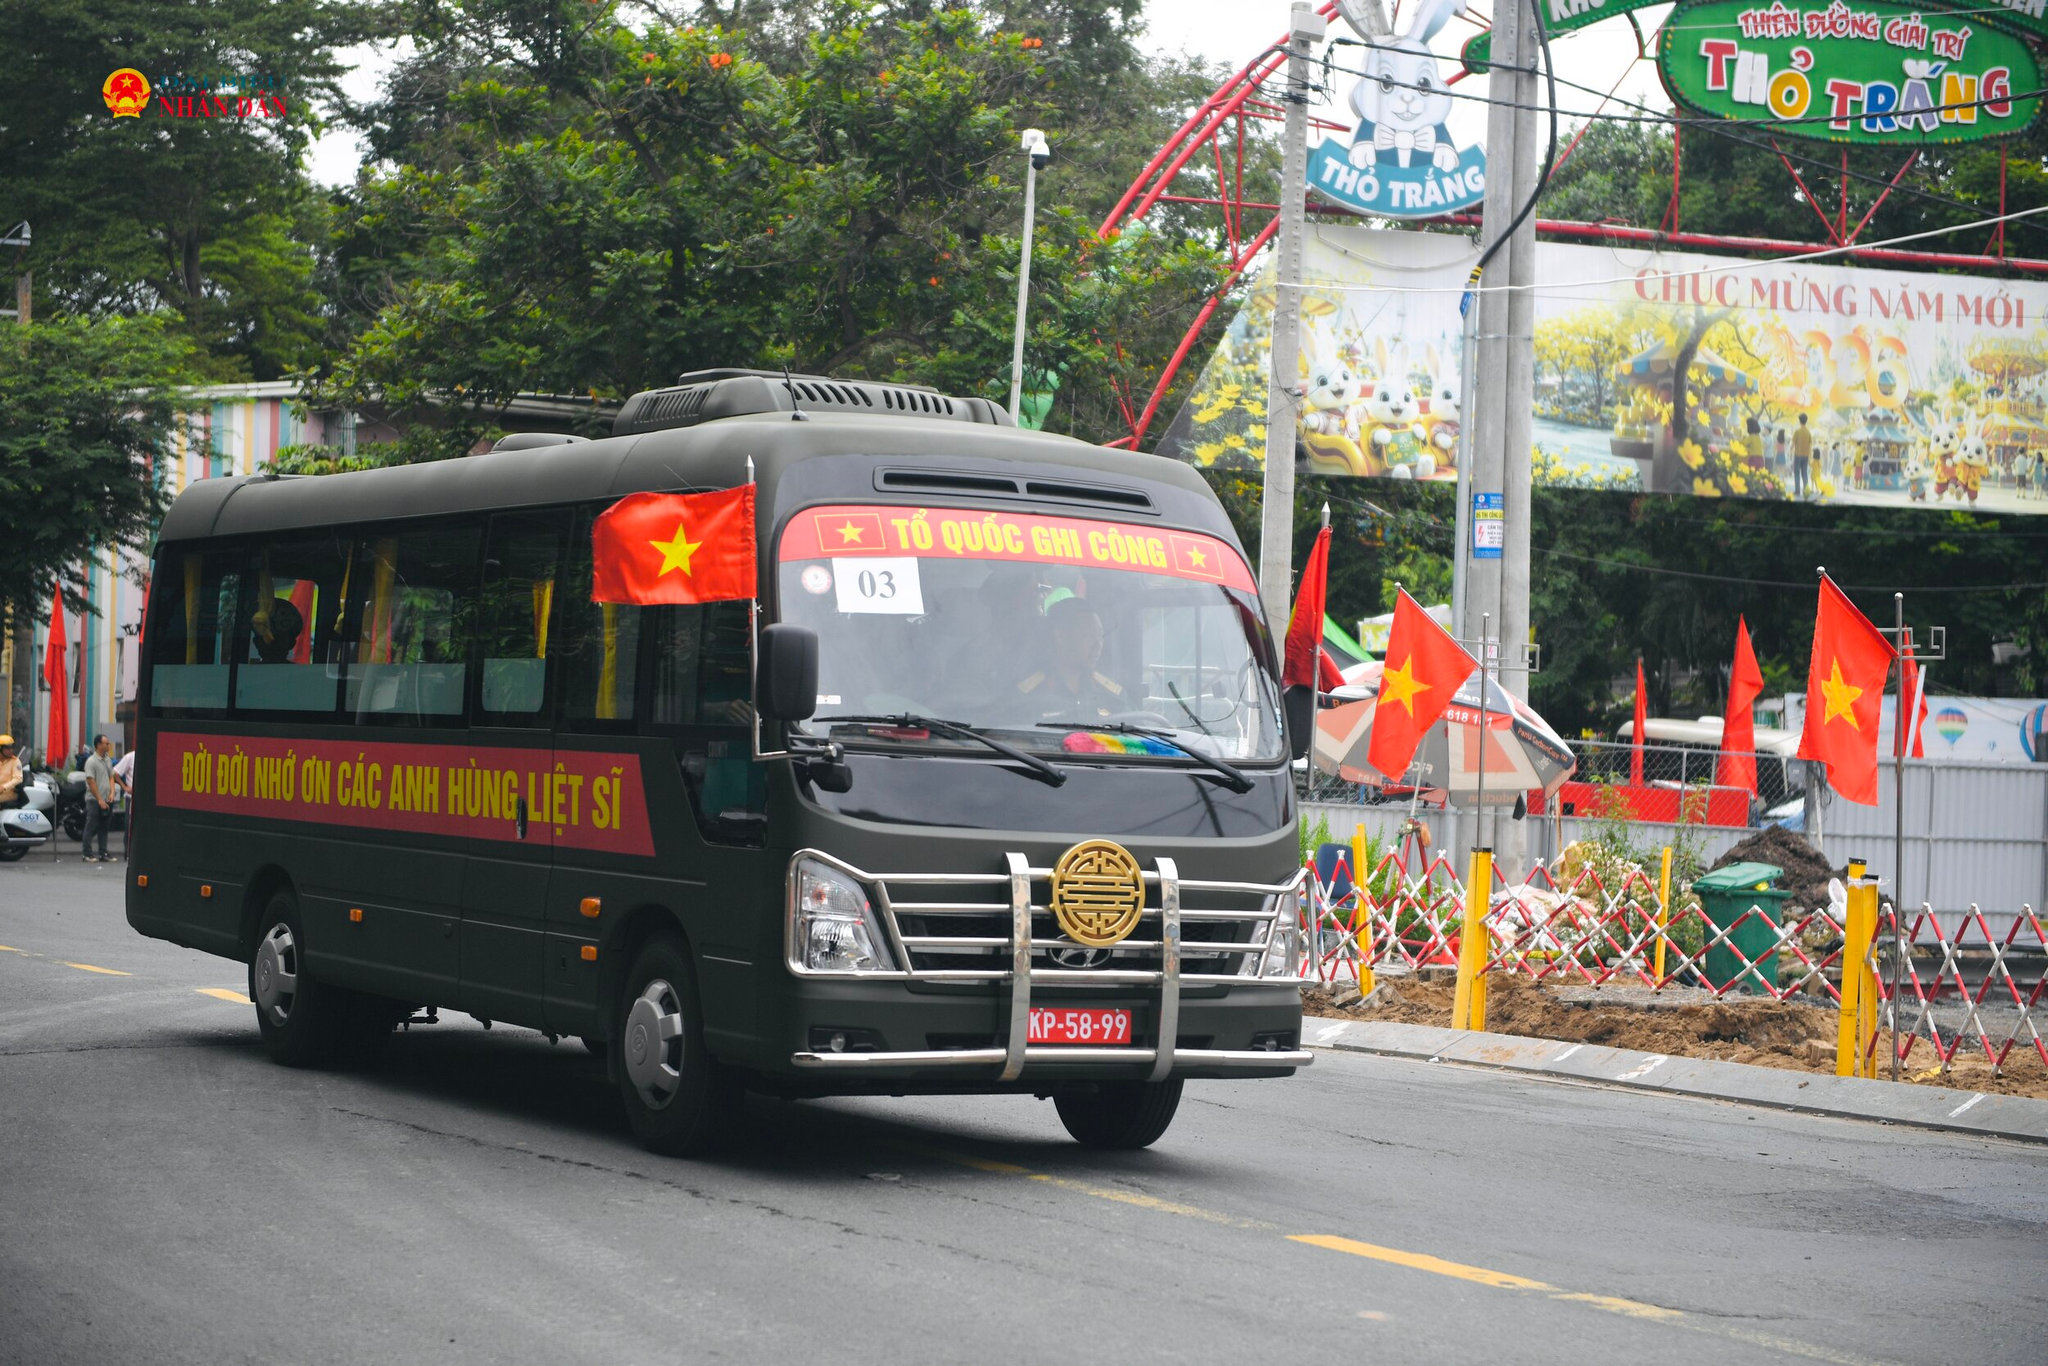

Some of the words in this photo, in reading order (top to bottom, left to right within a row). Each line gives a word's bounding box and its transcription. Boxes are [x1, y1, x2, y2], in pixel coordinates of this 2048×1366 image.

[1739, 3, 1798, 39] THIÊN
[1806, 1, 1878, 40] ĐƯỜNG
[1885, 15, 1928, 50] GIẢI
[1933, 27, 1969, 60] TRÍ
[1700, 39, 1814, 120] THỎ
[1828, 59, 2012, 133] TRẮNG
[1321, 156, 1380, 202] THỎ
[1388, 166, 1486, 209] TRẮNG
[1634, 265, 1740, 308] CHÚC
[1750, 272, 1857, 317] MỪNG
[1869, 283, 1944, 324] NĂM
[1956, 288, 2025, 329] MỚI
[892, 508, 933, 550] TỔ
[941, 512, 1024, 555] QUỐC
[1033, 525, 1082, 559] GHI
[1089, 527, 1168, 569] CÔNG
[858, 569, 897, 600] 03
[1447, 709, 1469, 723] 618
[1472, 714, 1493, 728] 11
[18, 813, 40, 821] CSGT
[182, 742, 212, 794] ĐỜI
[217, 744, 248, 797] ĐỜI
[254, 748, 297, 802] NHỚ
[301, 755, 332, 806] ƠN
[337, 752, 382, 809] CÁC
[388, 764, 440, 815] ANH
[447, 758, 519, 822] HÙNG
[527, 763, 584, 837] LIỆT
[591, 767, 624, 831] SĨ
[1029, 1011, 1127, 1040] KP-58-99
